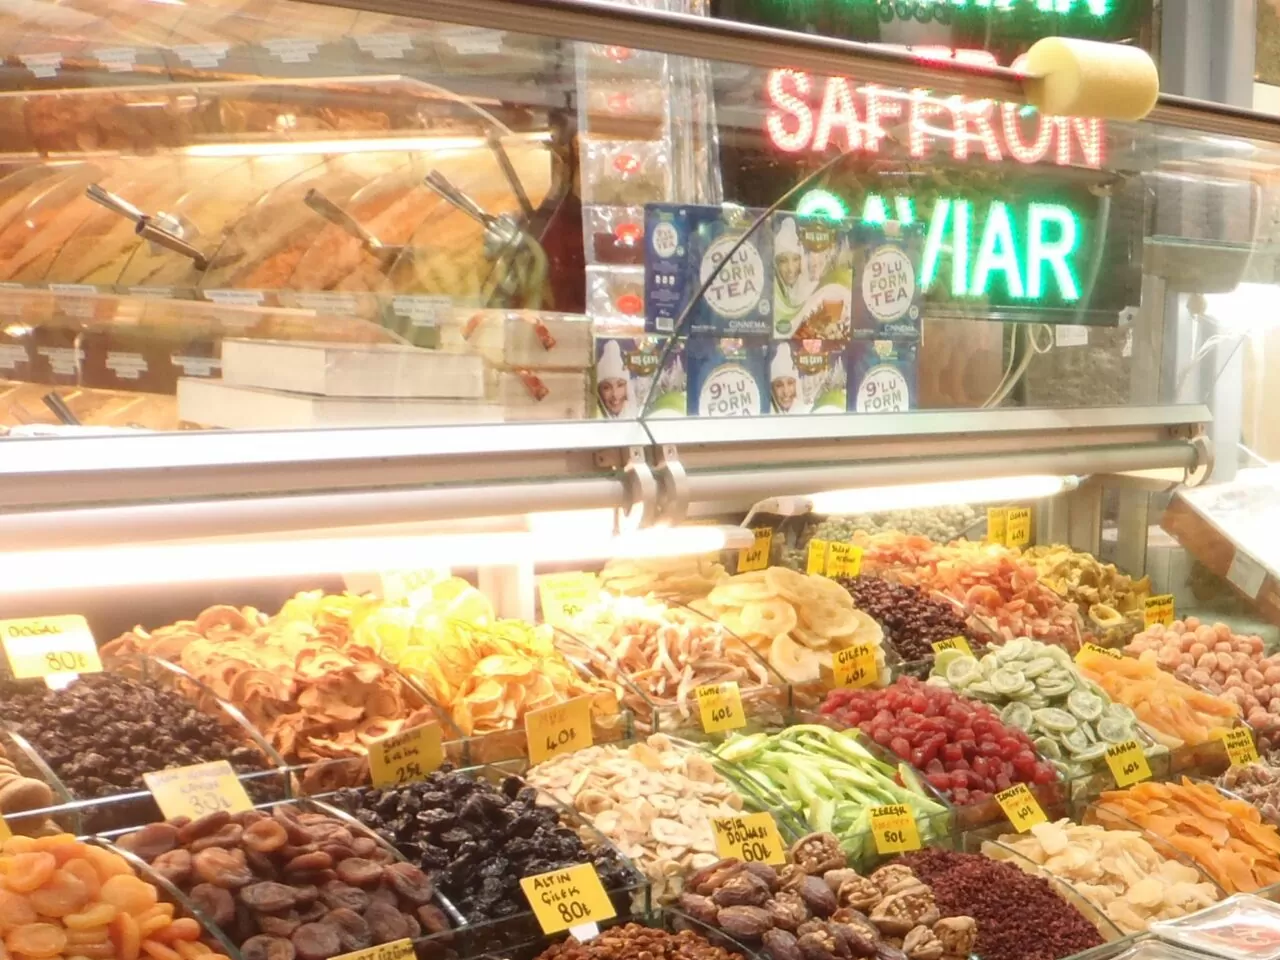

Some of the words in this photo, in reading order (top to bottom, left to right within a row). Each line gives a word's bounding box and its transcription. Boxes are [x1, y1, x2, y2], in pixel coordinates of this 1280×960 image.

[769, 67, 1106, 168] SAFFRON
[795, 189, 1082, 301] VIAR
[714, 264, 756, 283] ORM
[870, 274, 908, 293] FORM
[711, 280, 757, 300] TEA
[871, 290, 908, 306] TEA
[709, 379, 746, 400] 9'LU
[866, 380, 897, 397] 9'LU
[708, 395, 753, 416] FORM
[864, 391, 902, 414] FORM
